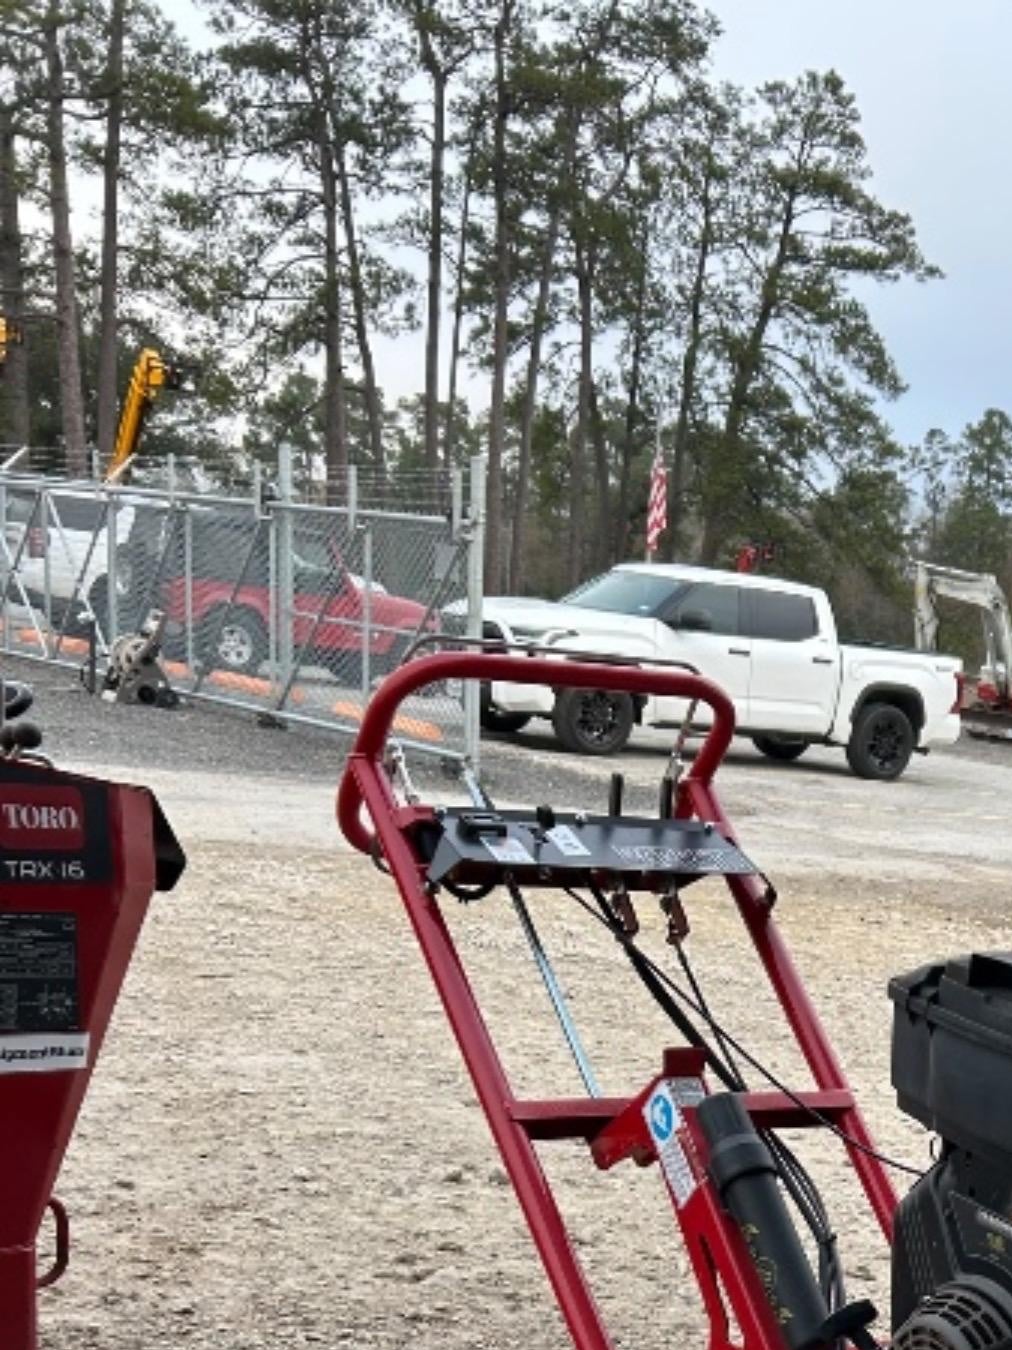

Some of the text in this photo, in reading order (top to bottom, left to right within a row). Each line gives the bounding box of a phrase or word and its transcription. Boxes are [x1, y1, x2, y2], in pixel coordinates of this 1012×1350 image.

[2, 804, 78, 830] TORO
[5, 860, 85, 879] TRX 16
